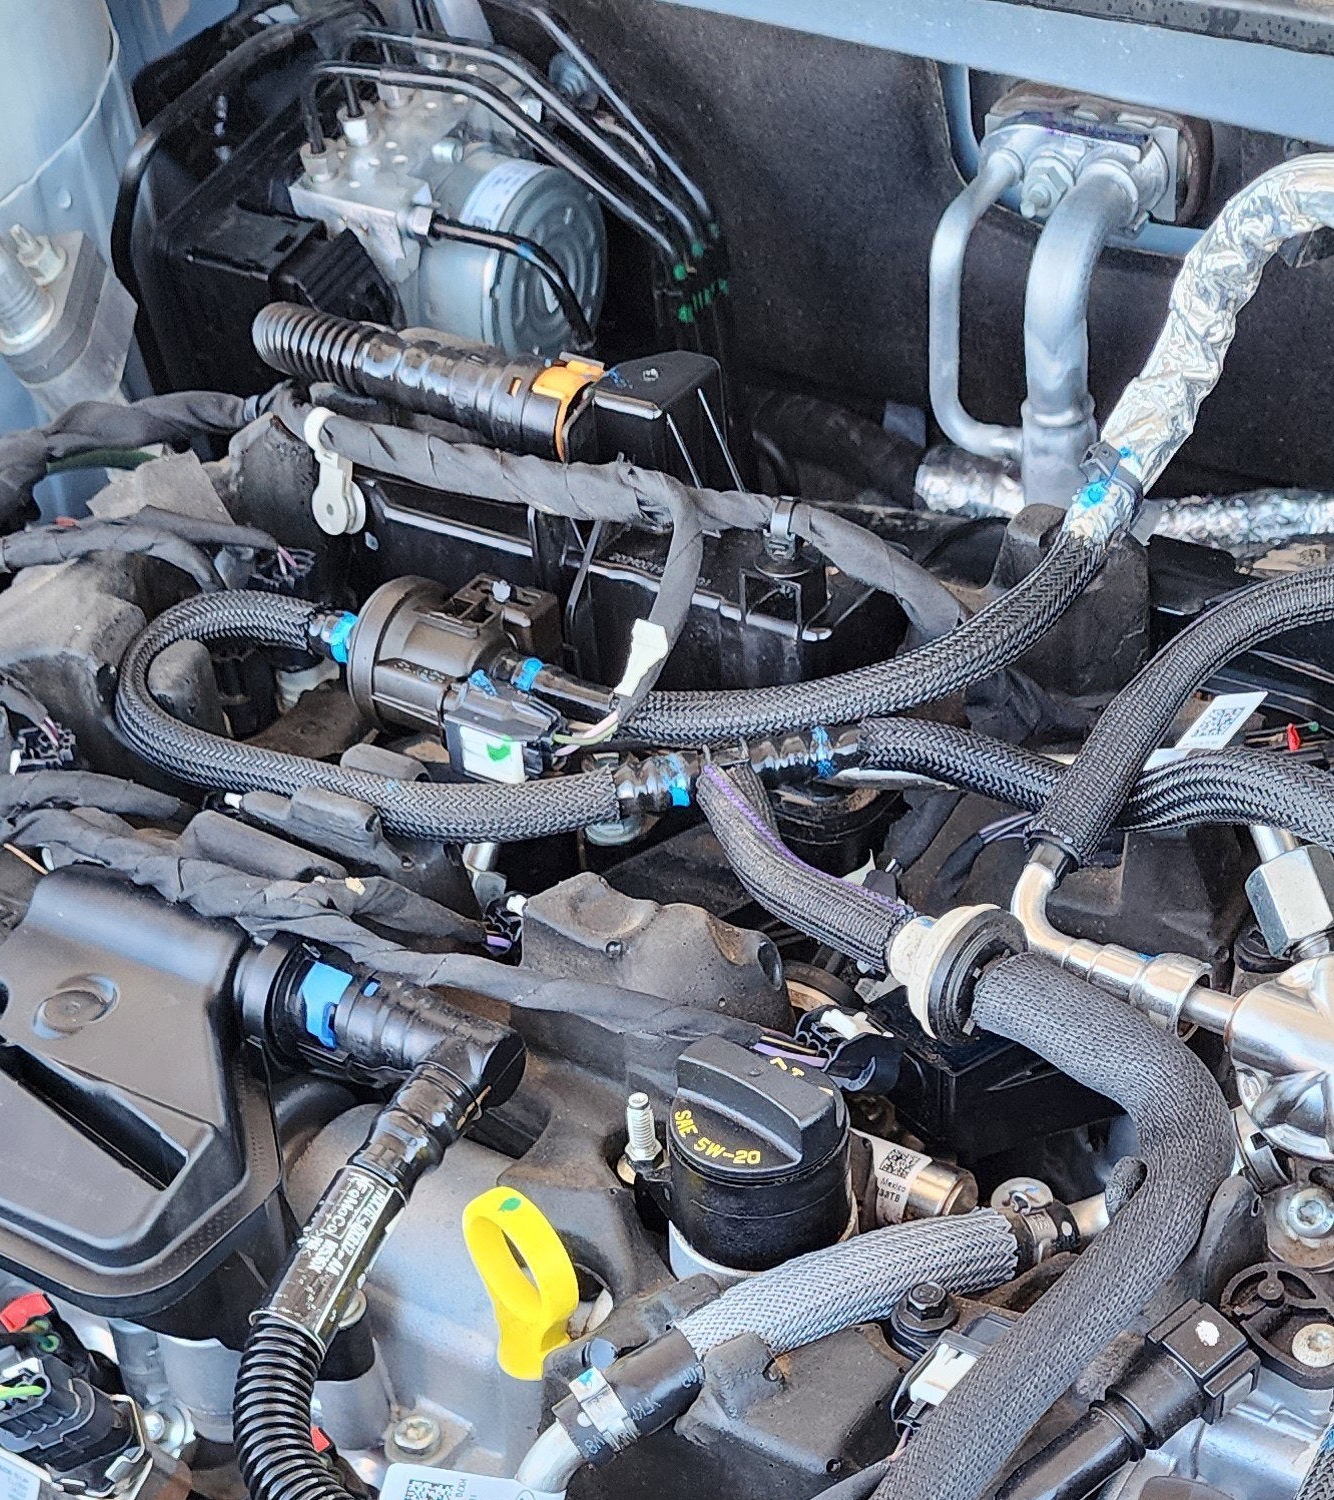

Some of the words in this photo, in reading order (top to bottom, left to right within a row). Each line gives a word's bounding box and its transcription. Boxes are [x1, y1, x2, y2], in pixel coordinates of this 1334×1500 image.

[675, 1110, 698, 1138] SAE
[694, 1137, 760, 1165] 5W-20
[880, 1177, 907, 1192] Mexico
